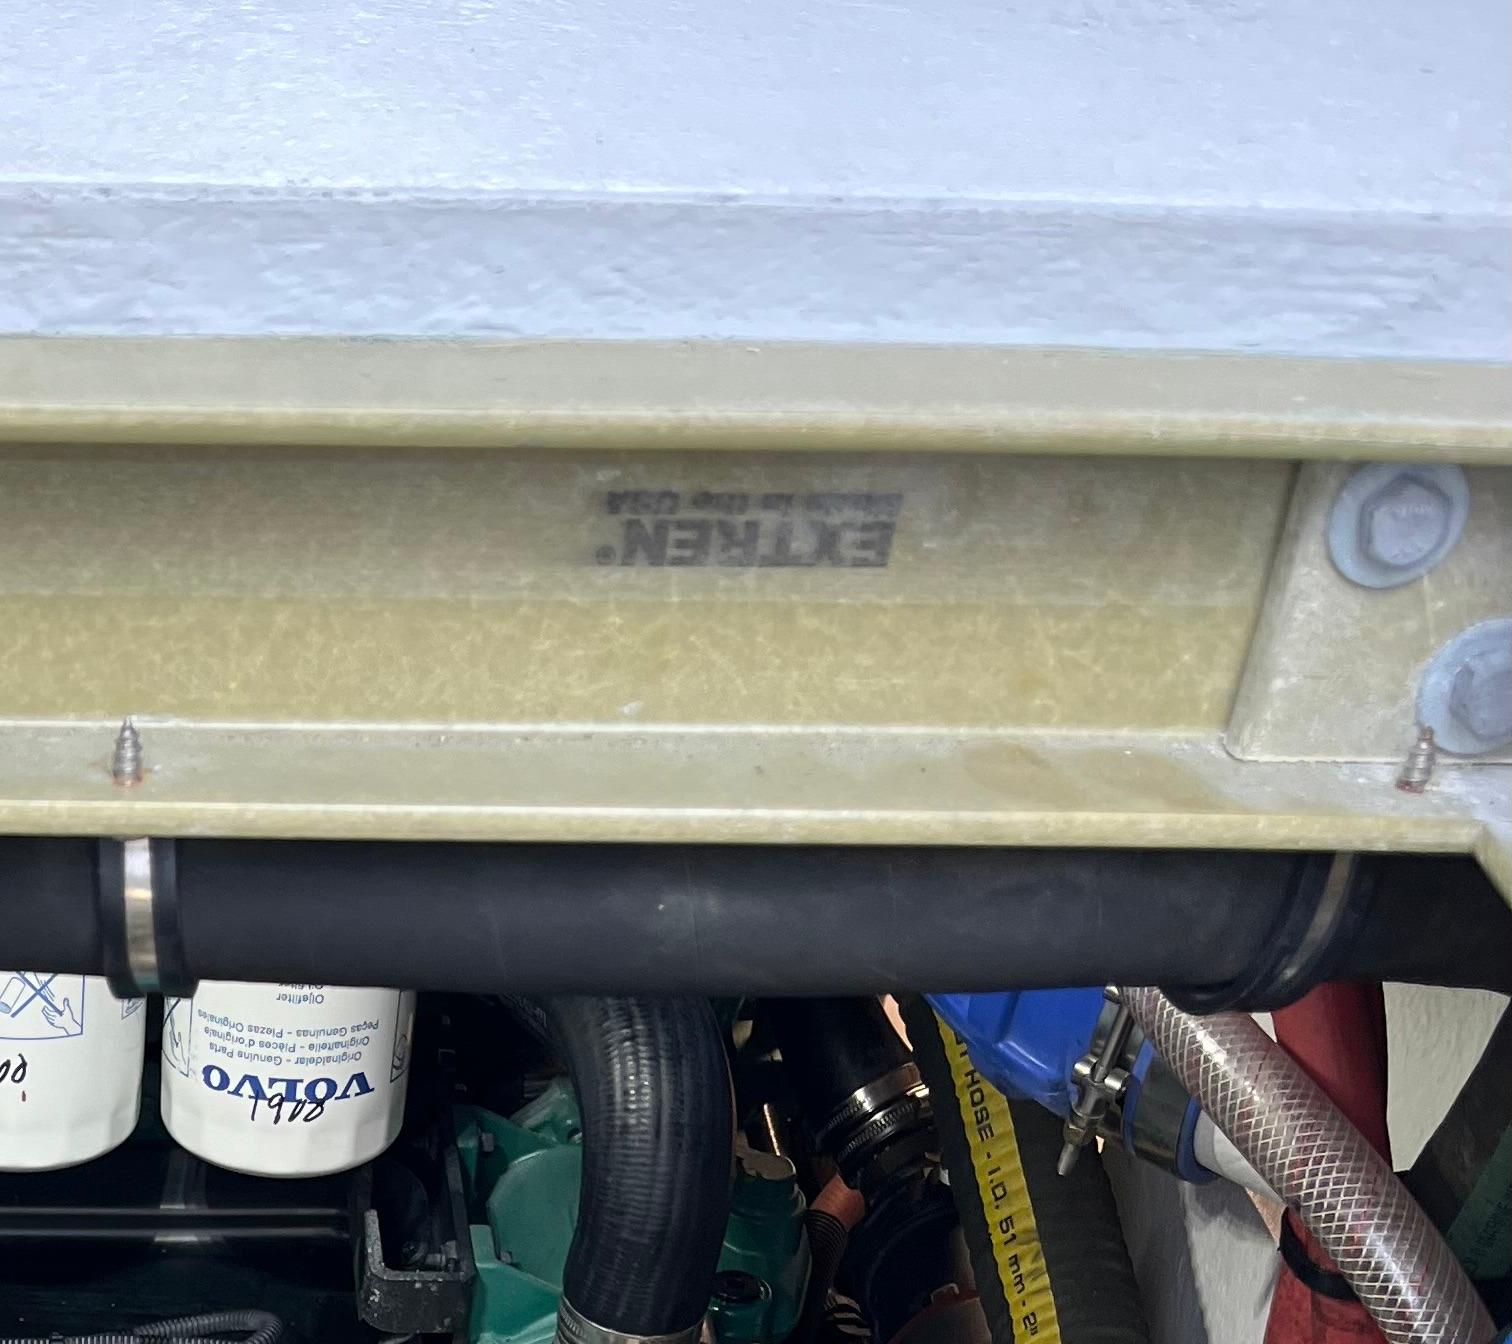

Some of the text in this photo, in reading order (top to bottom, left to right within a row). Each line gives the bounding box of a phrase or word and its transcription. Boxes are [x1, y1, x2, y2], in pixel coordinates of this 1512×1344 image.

[209, 1041, 234, 1058] Parts
[237, 1050, 282, 1066] Genuine
[294, 1050, 362, 1066] Originaldelar
[202, 1064, 375, 1103] VOLVO
[963, 1069, 994, 1142] HOSE
[998, 1214, 1017, 1246] 51
[1008, 1253, 1026, 1296] mm
